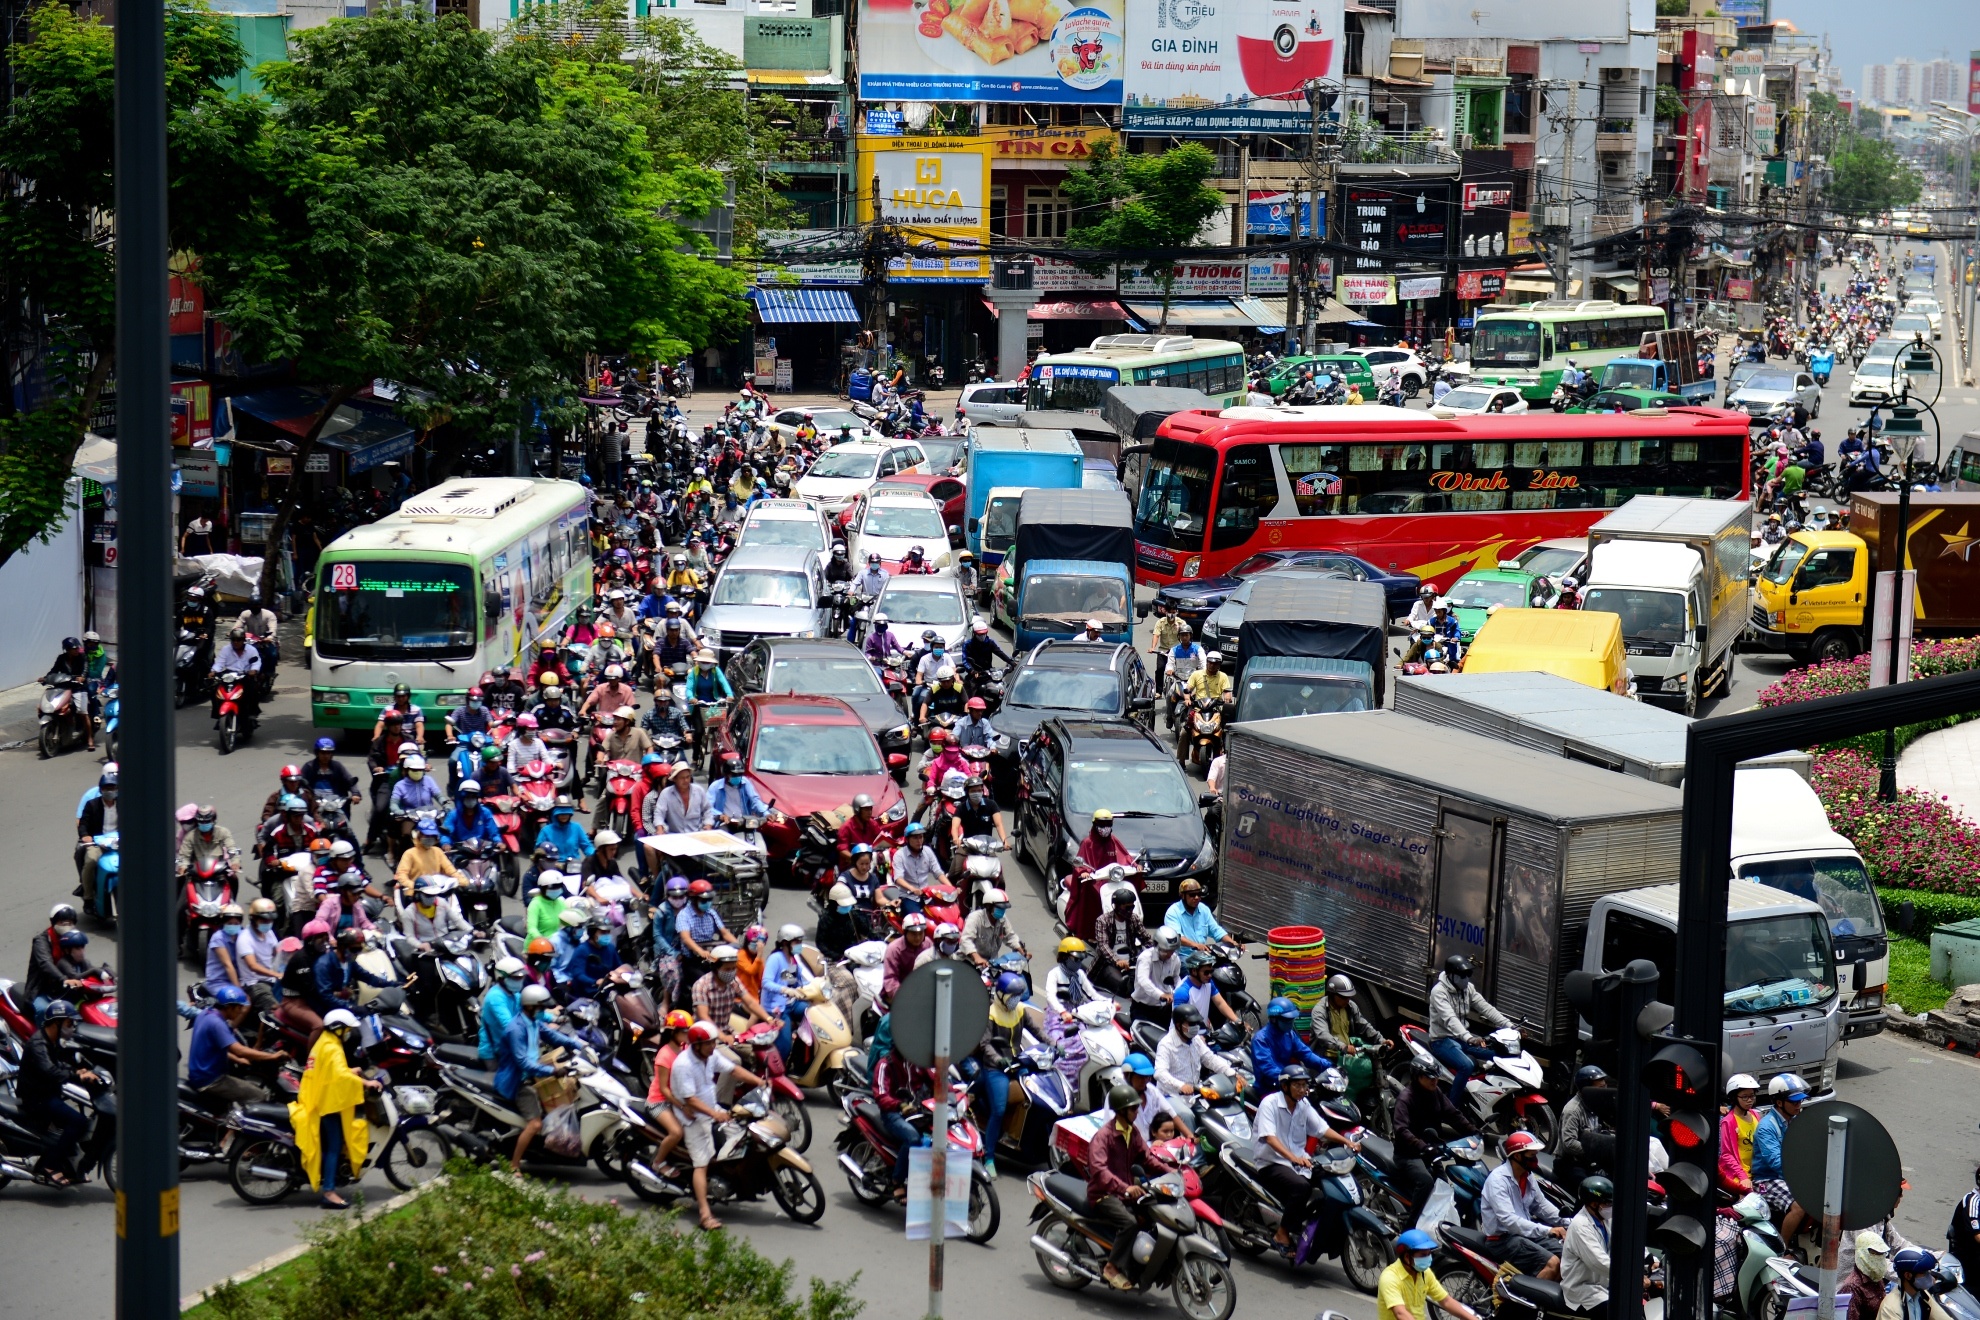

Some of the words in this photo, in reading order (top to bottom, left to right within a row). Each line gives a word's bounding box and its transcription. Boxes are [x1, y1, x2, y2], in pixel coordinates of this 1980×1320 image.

[1185, 6, 1215, 18] TRIỆU
[1152, 39, 1177, 53] GIA
[1182, 36, 1218, 53] ĐÌNH
[1165, 61, 1184, 72] dùng
[1195, 117, 1208, 127] GIA
[1250, 117, 1261, 127] GIA
[996, 140, 1045, 155] TIN
[1050, 139, 1088, 159] CẬ
[893, 189, 963, 209] HUCA
[1357, 206, 1387, 217] TRUNG
[900, 216, 910, 224] XA
[912, 213, 931, 224] BẰNG
[1362, 220, 1381, 233] TÂM
[1361, 237, 1380, 250] BẢO
[1649, 267, 1670, 277] LED
[1344, 278, 1363, 288] BÁN
[1365, 278, 1389, 288] HÀNG
[1349, 289, 1367, 299] TRẢ
[1370, 289, 1387, 299] GÓP
[1041, 368, 1053, 377] 145
[1296, 480, 1314, 495] FREE
[1326, 479, 1342, 495] WIFI
[1429, 470, 1510, 491] Vinh
[334, 566, 354, 585] 28
[1239, 788, 1281, 811] Sound
[1284, 803, 1340, 831] Lighting
[1350, 823, 1391, 845] Stage
[1400, 840, 1429, 855] Led
[854, 884, 870, 898] H
[1761, 1051, 1796, 1064] ISUZU
